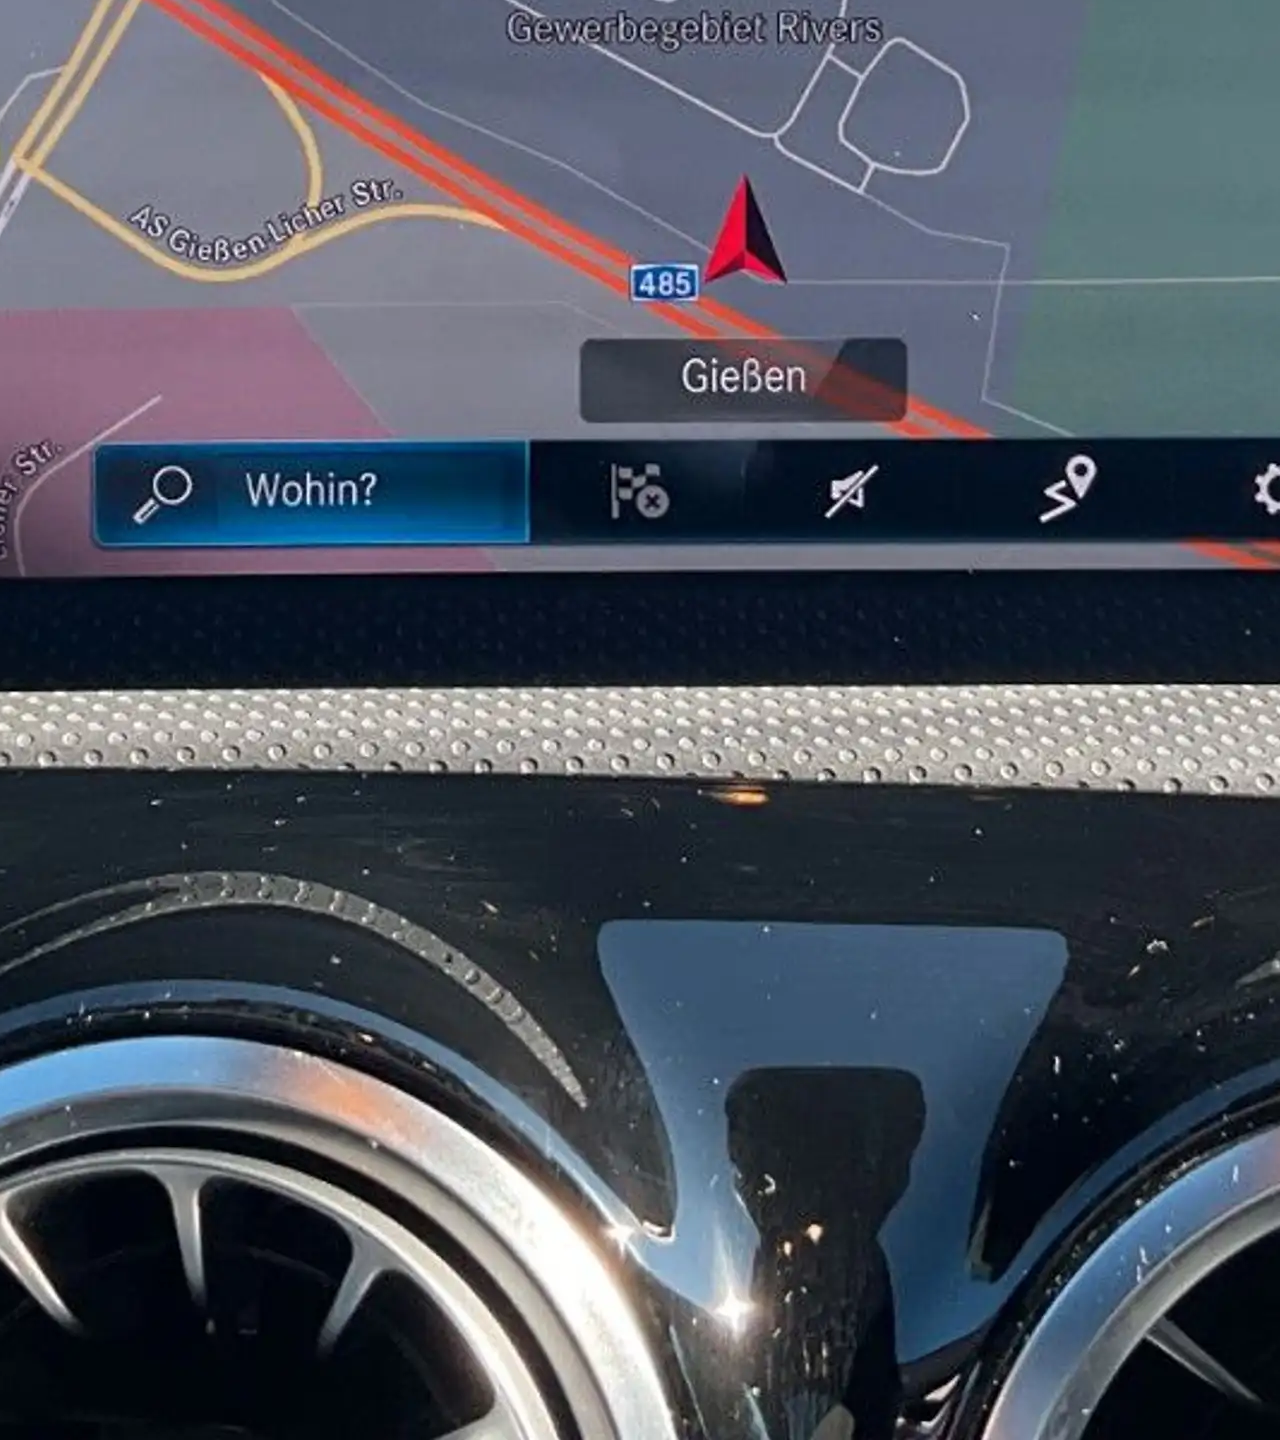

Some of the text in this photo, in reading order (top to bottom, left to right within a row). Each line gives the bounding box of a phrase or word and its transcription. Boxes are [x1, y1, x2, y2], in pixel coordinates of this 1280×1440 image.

[506, 11, 884, 52] Gewerbegebiet Rivers
[130, 177, 404, 262] AS Gießen Licher Str.
[638, 270, 693, 297] 485
[681, 357, 807, 393] Gießen
[14, 439, 64, 476] Str.
[245, 471, 378, 507] Wohin?
